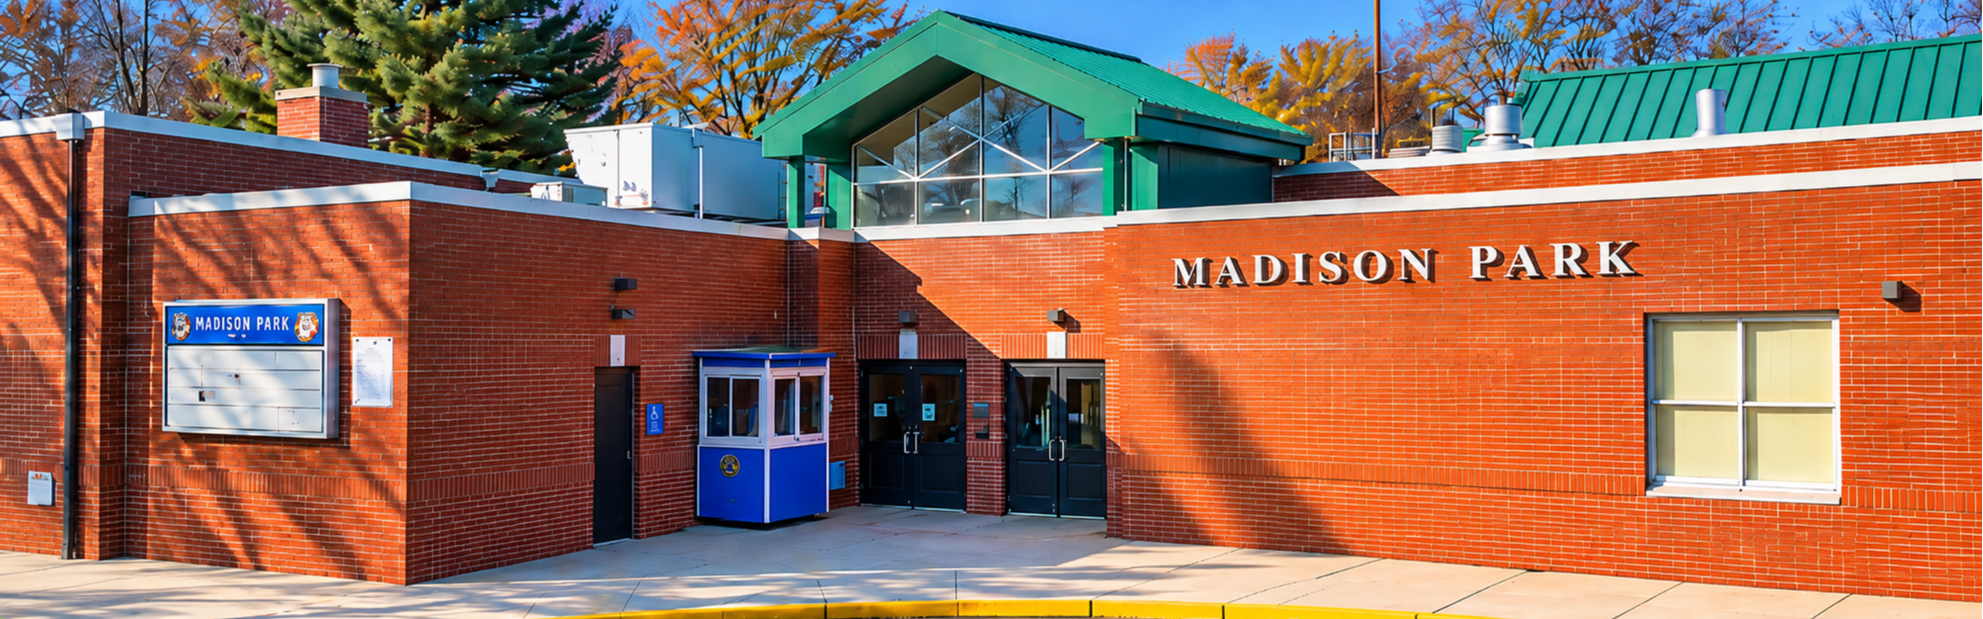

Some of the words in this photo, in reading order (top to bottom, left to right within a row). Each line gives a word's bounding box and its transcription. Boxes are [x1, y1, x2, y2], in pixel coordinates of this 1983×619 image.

[1171, 248, 1434, 288] MADISON
[1468, 240, 1637, 280] PARK
[195, 316, 251, 331] MADISON
[256, 316, 290, 331] PARK
